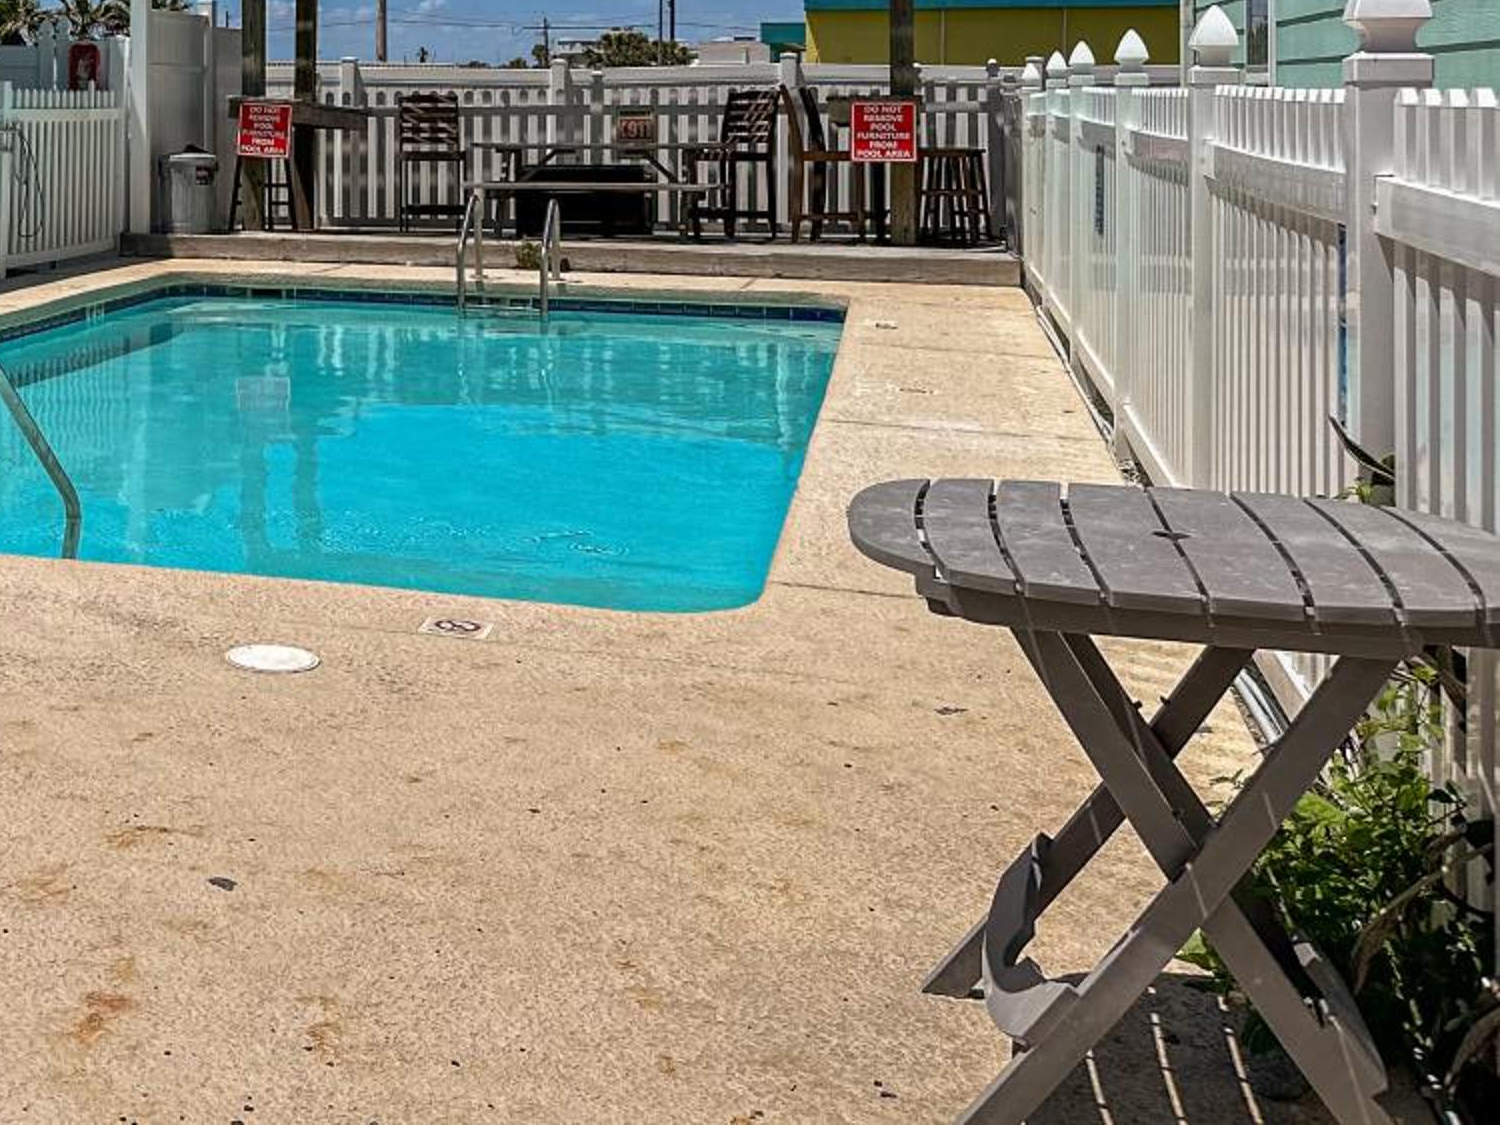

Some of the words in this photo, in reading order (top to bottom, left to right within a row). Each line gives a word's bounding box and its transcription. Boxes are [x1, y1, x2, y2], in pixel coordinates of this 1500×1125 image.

[864, 106, 879, 114] DO
[881, 106, 903, 114] NOT
[863, 114, 904, 123] REMOVE
[253, 122, 275, 131] POOL
[869, 122, 897, 132] POOL
[856, 132, 911, 140] FURNITURE
[869, 140, 898, 149] FROM
[241, 144, 262, 154] POOL
[263, 146, 286, 155] AREA
[856, 149, 883, 158] POOL
[884, 150, 911, 158] AREA
